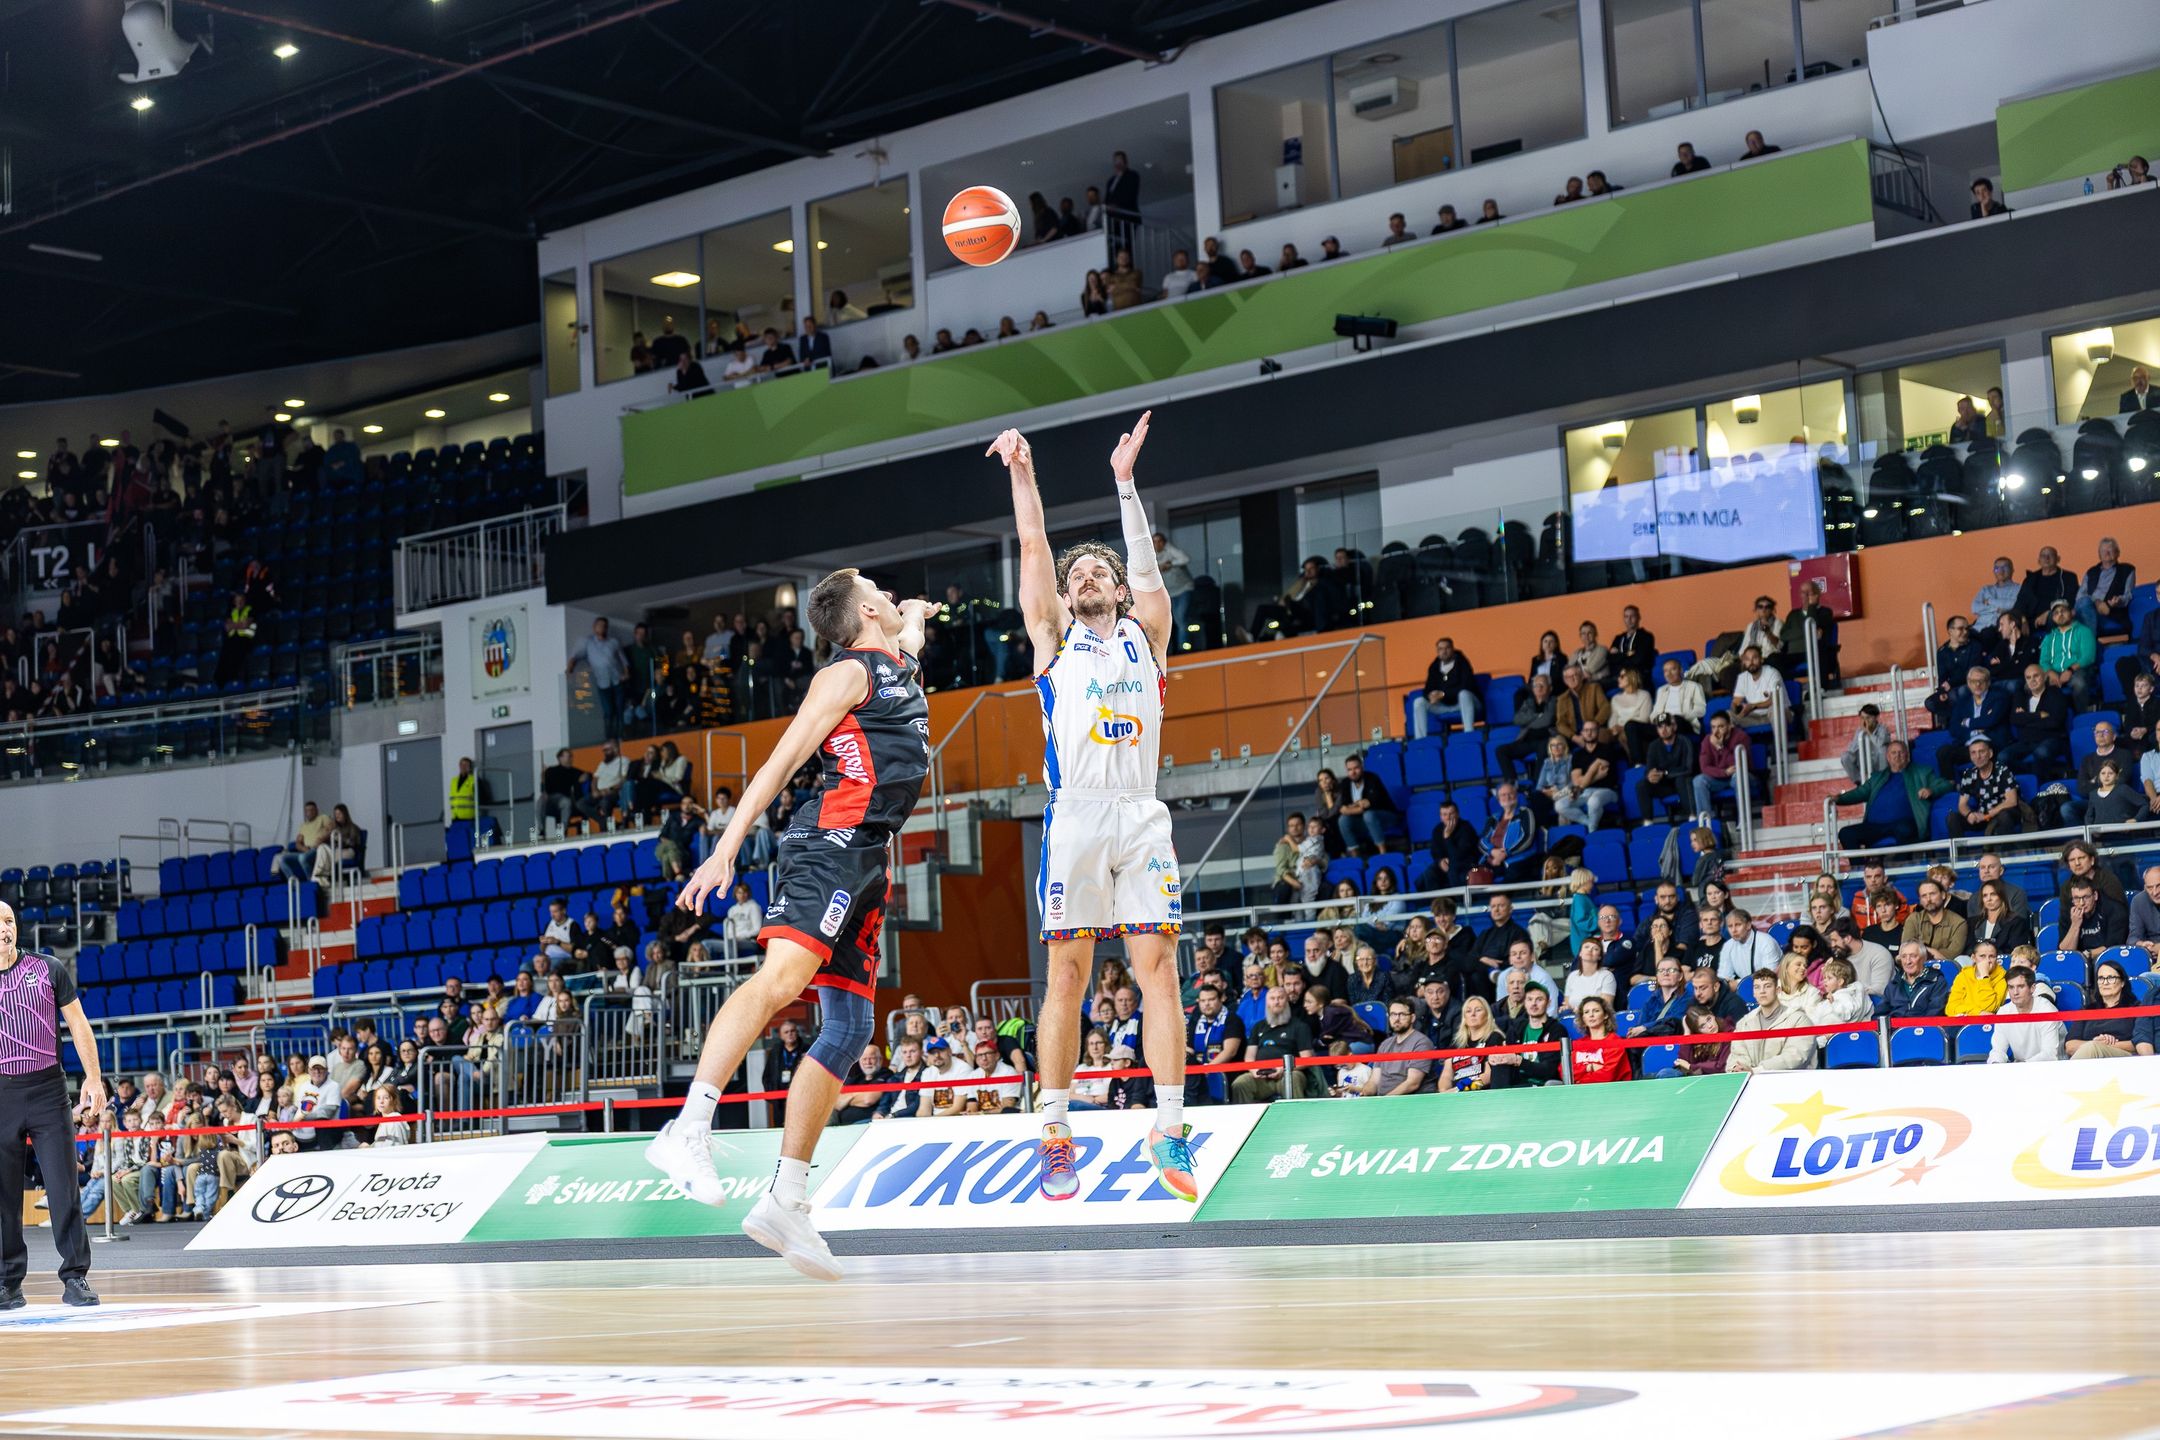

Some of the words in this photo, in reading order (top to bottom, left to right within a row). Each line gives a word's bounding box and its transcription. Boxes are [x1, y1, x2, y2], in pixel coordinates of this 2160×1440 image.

[954, 234, 987, 248] molten
[31, 545, 70, 579] T2
[1123, 640, 1138, 664] 0
[1311, 1144, 1450, 1178] ŚWIAT
[1447, 1135, 1665, 1172] ZDROWIA
[1771, 1123, 1924, 1178] LOTTO
[360, 1172, 442, 1197] Toyota
[553, 1176, 655, 1205] ŚWIAT
[331, 1200, 463, 1223] Bednarscy
